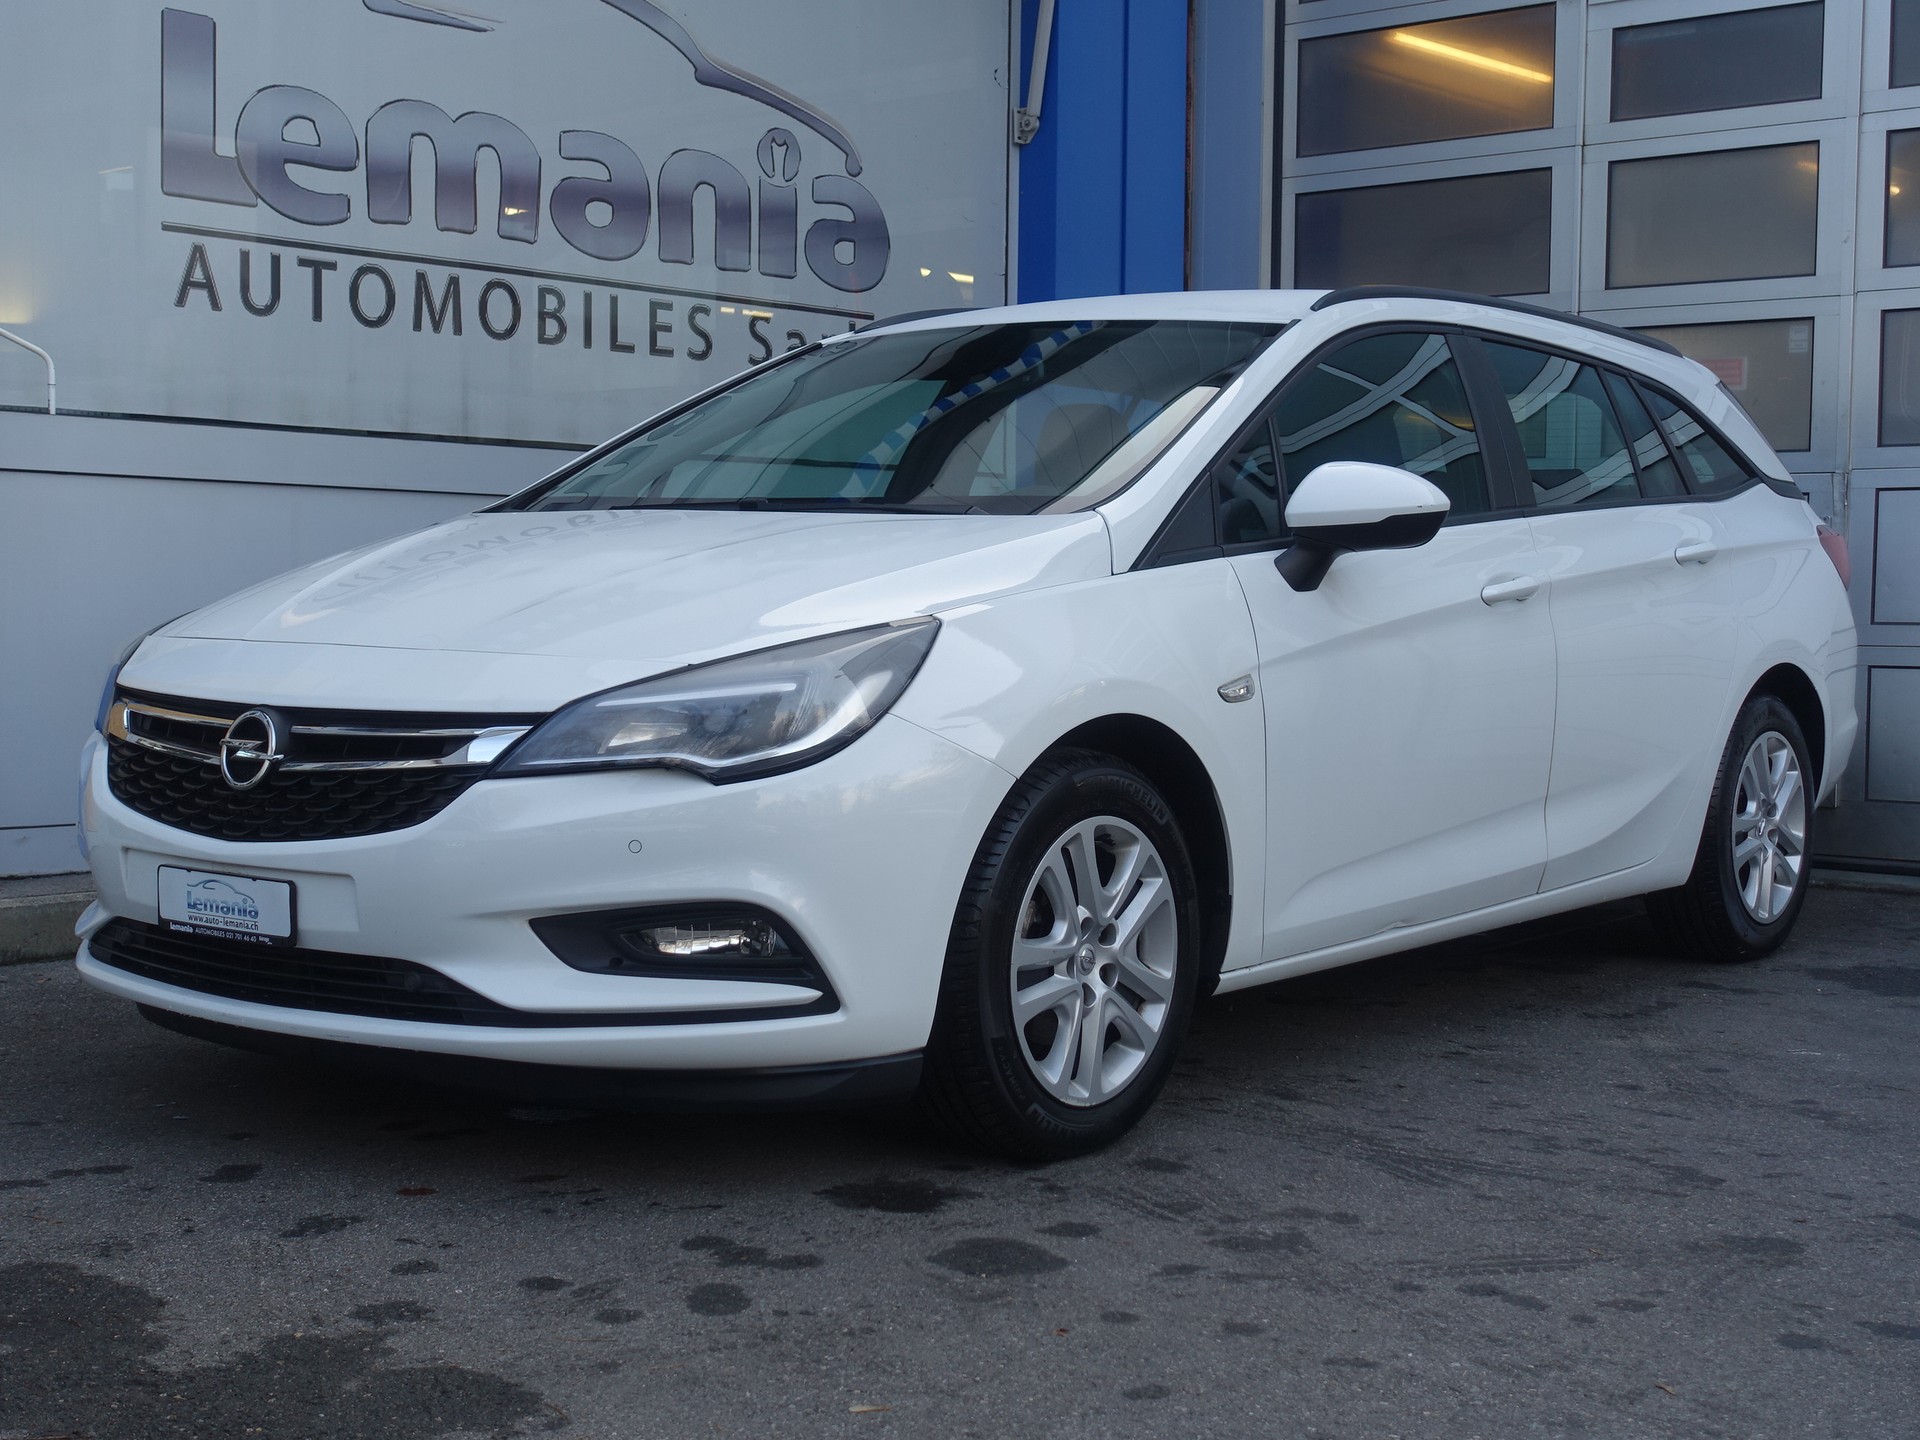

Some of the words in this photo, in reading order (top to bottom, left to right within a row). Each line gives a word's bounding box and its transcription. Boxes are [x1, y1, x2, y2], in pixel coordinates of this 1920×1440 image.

[161, 7, 890, 293] Lemania
[174, 242, 713, 361] AUTOMOBILES
[748, 314, 856, 366] Sa
[187, 890, 259, 919] Lemania
[188, 913, 259, 931] www.auto-lemania.ch
[195, 927, 225, 938] AUTOMOBILES
